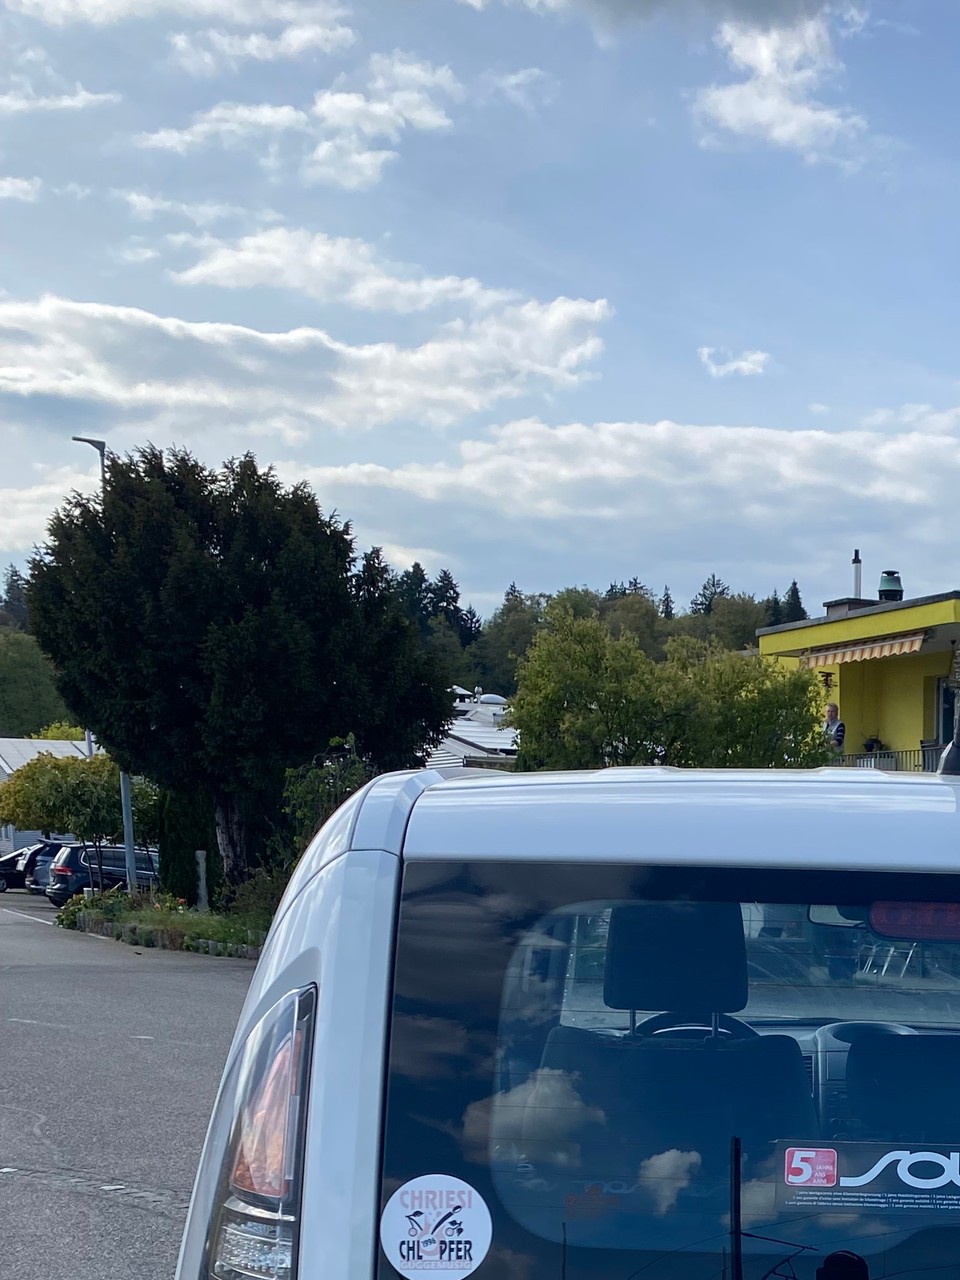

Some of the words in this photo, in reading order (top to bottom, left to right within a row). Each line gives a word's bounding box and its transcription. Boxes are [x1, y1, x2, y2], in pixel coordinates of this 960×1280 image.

[788, 1151, 816, 1183] 5
[400, 1190, 473, 1210] CHRIESI
[400, 1261, 472, 1271] GUGGEMUSIG
